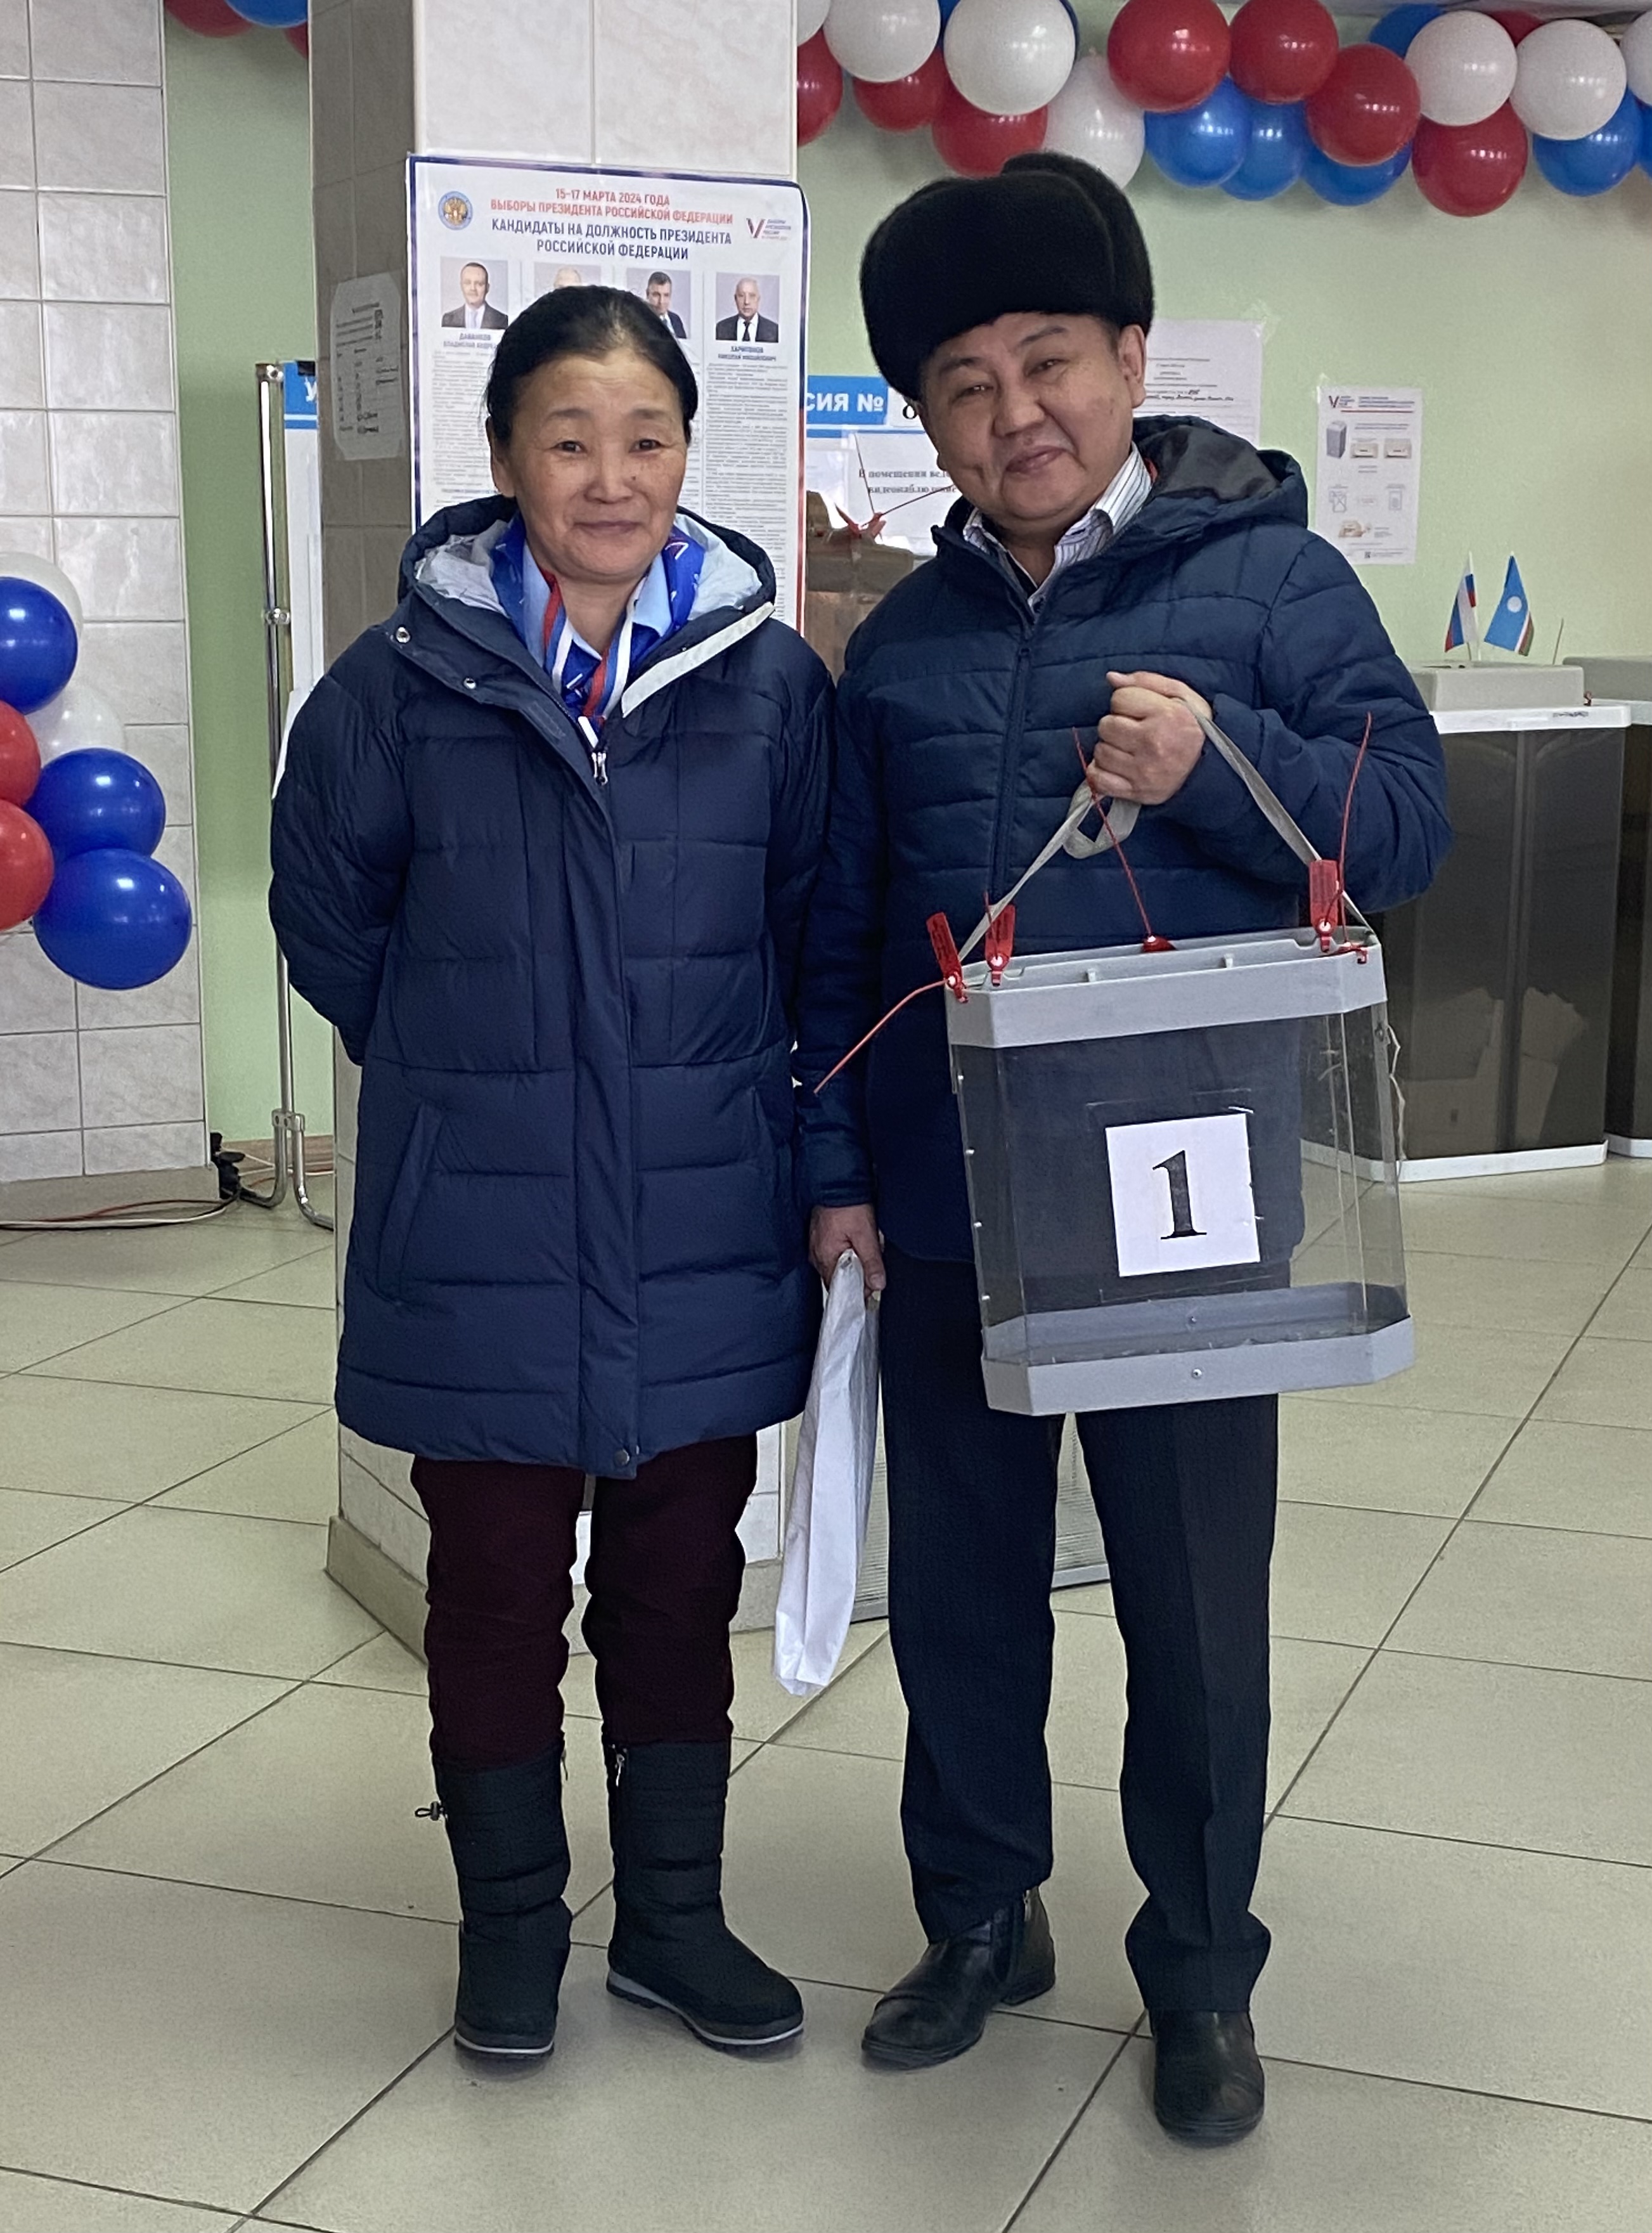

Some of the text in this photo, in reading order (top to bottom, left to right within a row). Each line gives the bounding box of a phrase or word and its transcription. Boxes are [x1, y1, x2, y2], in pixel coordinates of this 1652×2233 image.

[583, 190, 616, 202] МАРТА
[619, 192, 642, 204] 2024
[645, 194, 670, 207] ГОДА
[491, 199, 733, 225] ВЫБОРЫ ПРЕЗИДЕНТА РОССИЙСКОЙ ФЕДЕРАЦИИ
[492, 219, 732, 245] КАНДИДАТЫ НА ДОЛЖНОСТЬ ПРЕЗИДЕНТА
[537, 239, 688, 261] РОССИЙСКОЙ ФЕДЕРАЦИИ
[857, 393, 884, 412] №
[1152, 1150, 1207, 1239] 1
